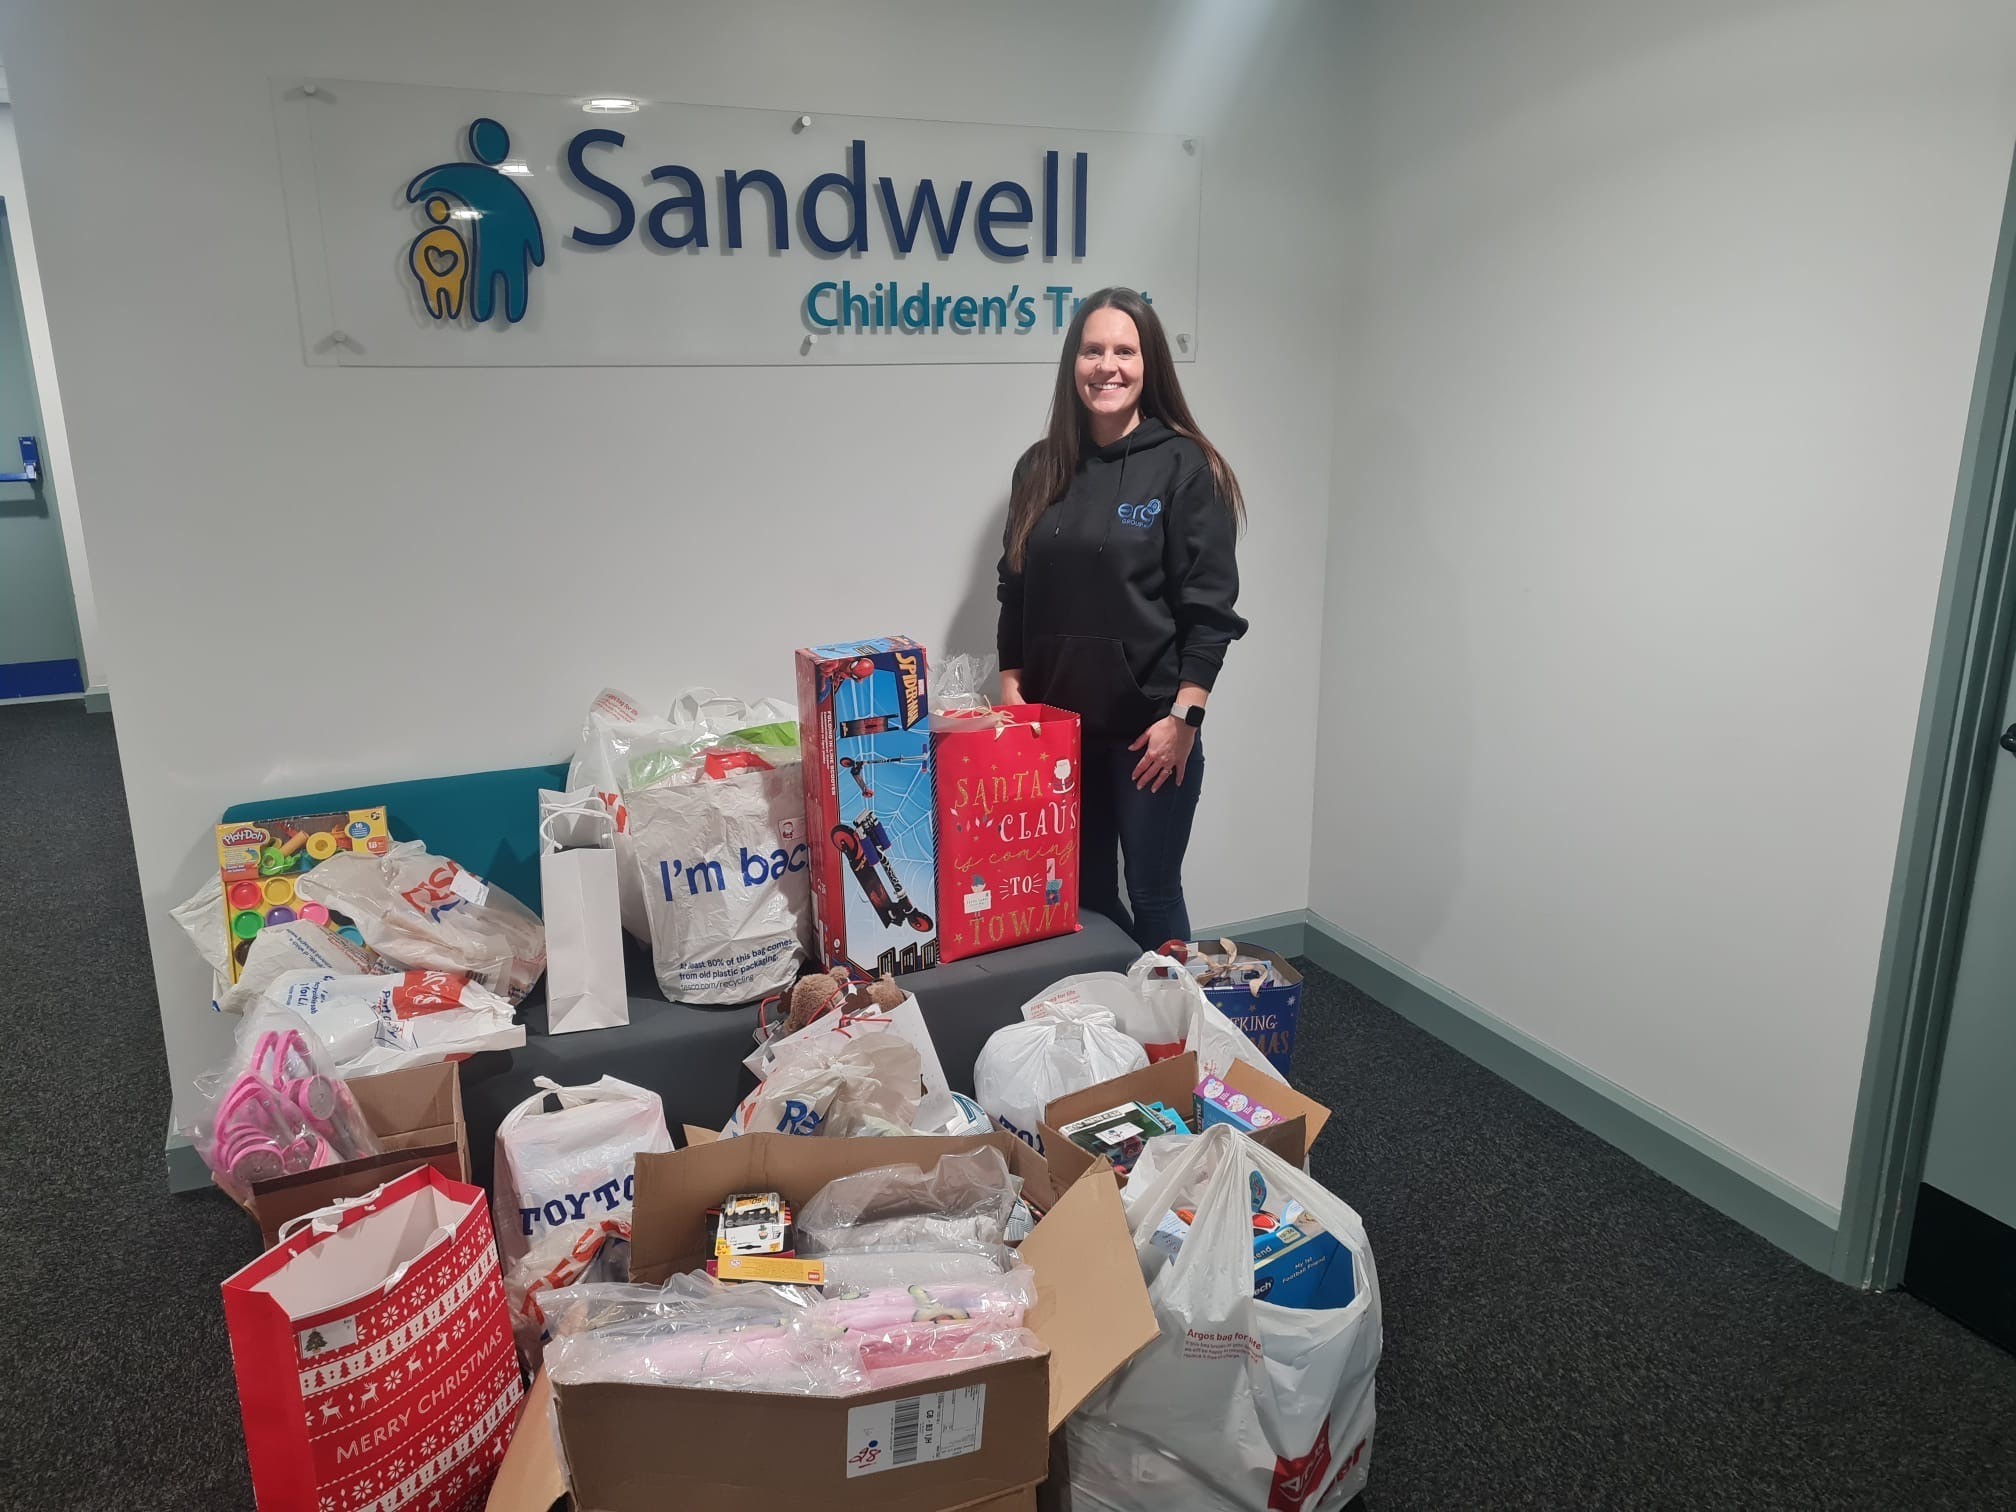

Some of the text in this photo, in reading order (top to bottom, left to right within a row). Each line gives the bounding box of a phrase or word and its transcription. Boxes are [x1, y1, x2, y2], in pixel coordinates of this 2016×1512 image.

[566, 128, 1088, 258] Sandwell
[806, 281, 1153, 328] Children's Trt
[954, 769, 1044, 816] SANTA
[1000, 800, 1078, 843] CLAUS
[660, 859, 726, 902] I'm
[740, 843, 810, 888] bac
[1010, 874, 1033, 896] TO
[969, 902, 1070, 946] TOWN!
[679, 969, 698, 981] from
[699, 967, 711, 979] old
[712, 965, 739, 979] plastic
[707, 957, 724, 970] 80%
[726, 956, 735, 967] of
[736, 952, 751, 963] this
[766, 937, 793, 951] comes
[1254, 1281, 1272, 1298] ech
[1282, 1266, 1307, 1284] Football
[1187, 1328, 1215, 1341] Argos
[1216, 1333, 1233, 1342] bag
[1235, 1332, 1248, 1340] for
[335, 1325, 503, 1465] MERRY CHRISTMAS
